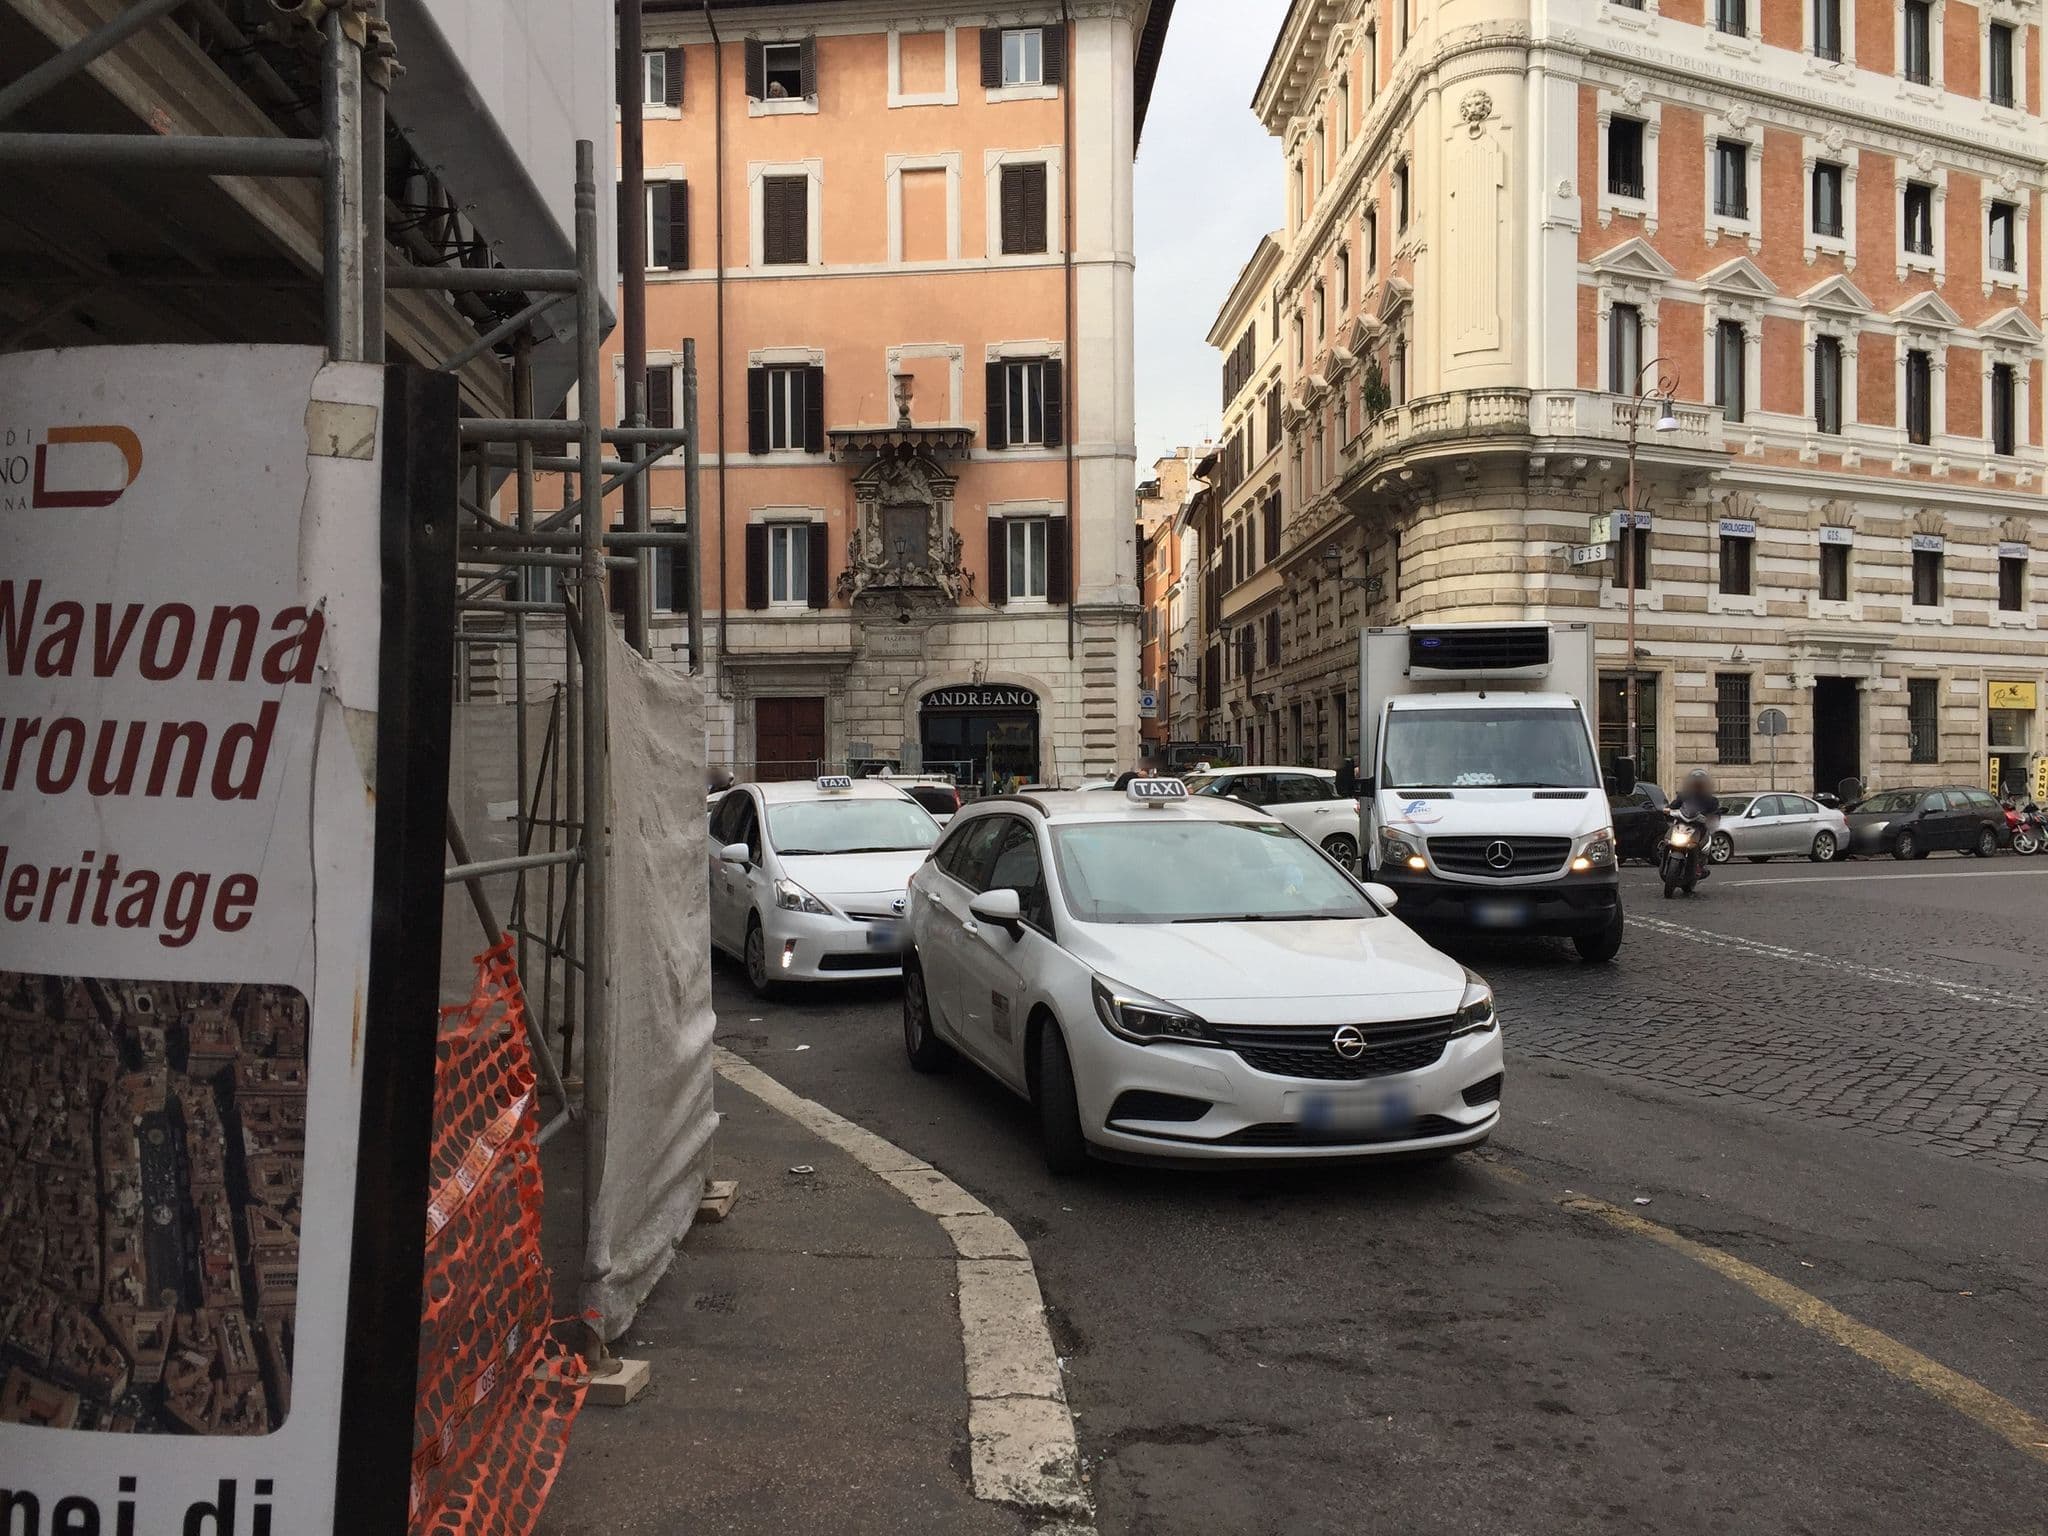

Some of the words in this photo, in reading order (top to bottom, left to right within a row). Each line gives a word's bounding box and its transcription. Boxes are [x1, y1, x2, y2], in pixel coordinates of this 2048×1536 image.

[1669, 53, 1722, 76] TORLONIA
[1721, 521, 1754, 534] OROLOGERIA
[0, 579, 326, 684] Navona
[927, 691, 1033, 706] ANDREANO
[0, 701, 280, 800] round
[822, 778, 850, 787] TAXI
[1136, 782, 1180, 795] TAXI
[2038, 759, 2047, 797] FORNO
[0, 846, 258, 947] eritage
